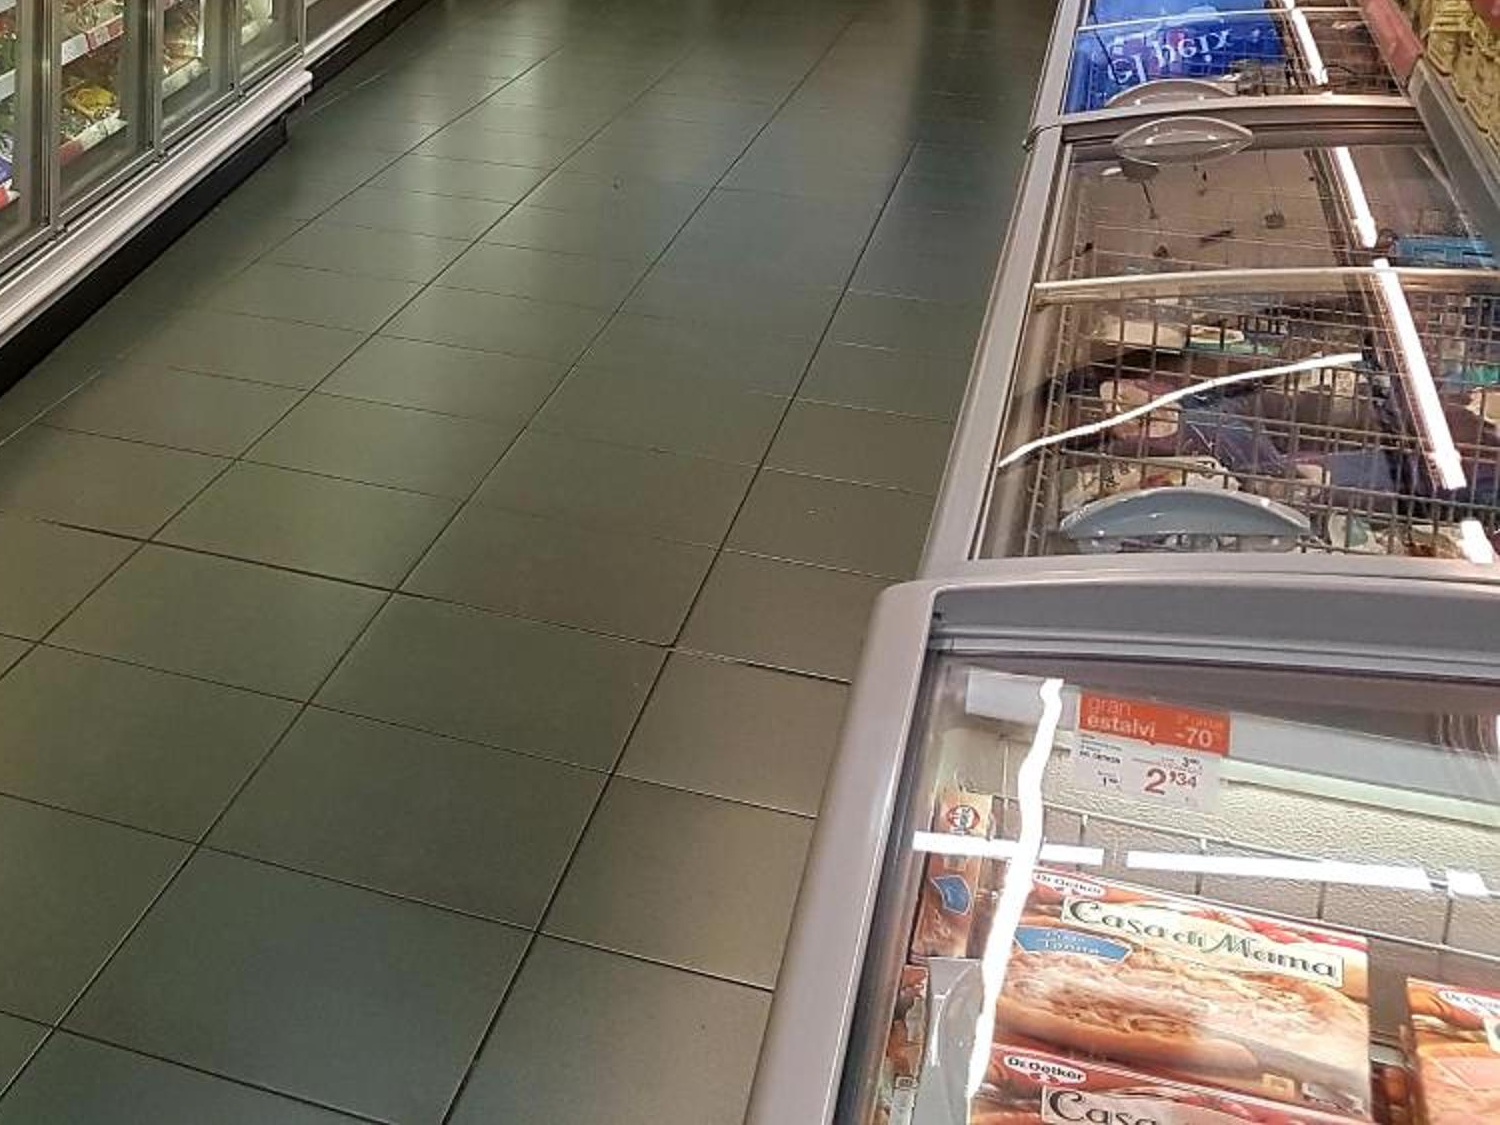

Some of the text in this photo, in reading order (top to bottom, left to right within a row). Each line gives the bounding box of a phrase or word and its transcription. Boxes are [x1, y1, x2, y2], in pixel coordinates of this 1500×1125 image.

[1088, 697, 1132, 715] gran
[1087, 712, 1156, 739] estalvi
[1069, 899, 1338, 979] Casa di Mama
[1048, 1089, 1158, 1125] Casa
